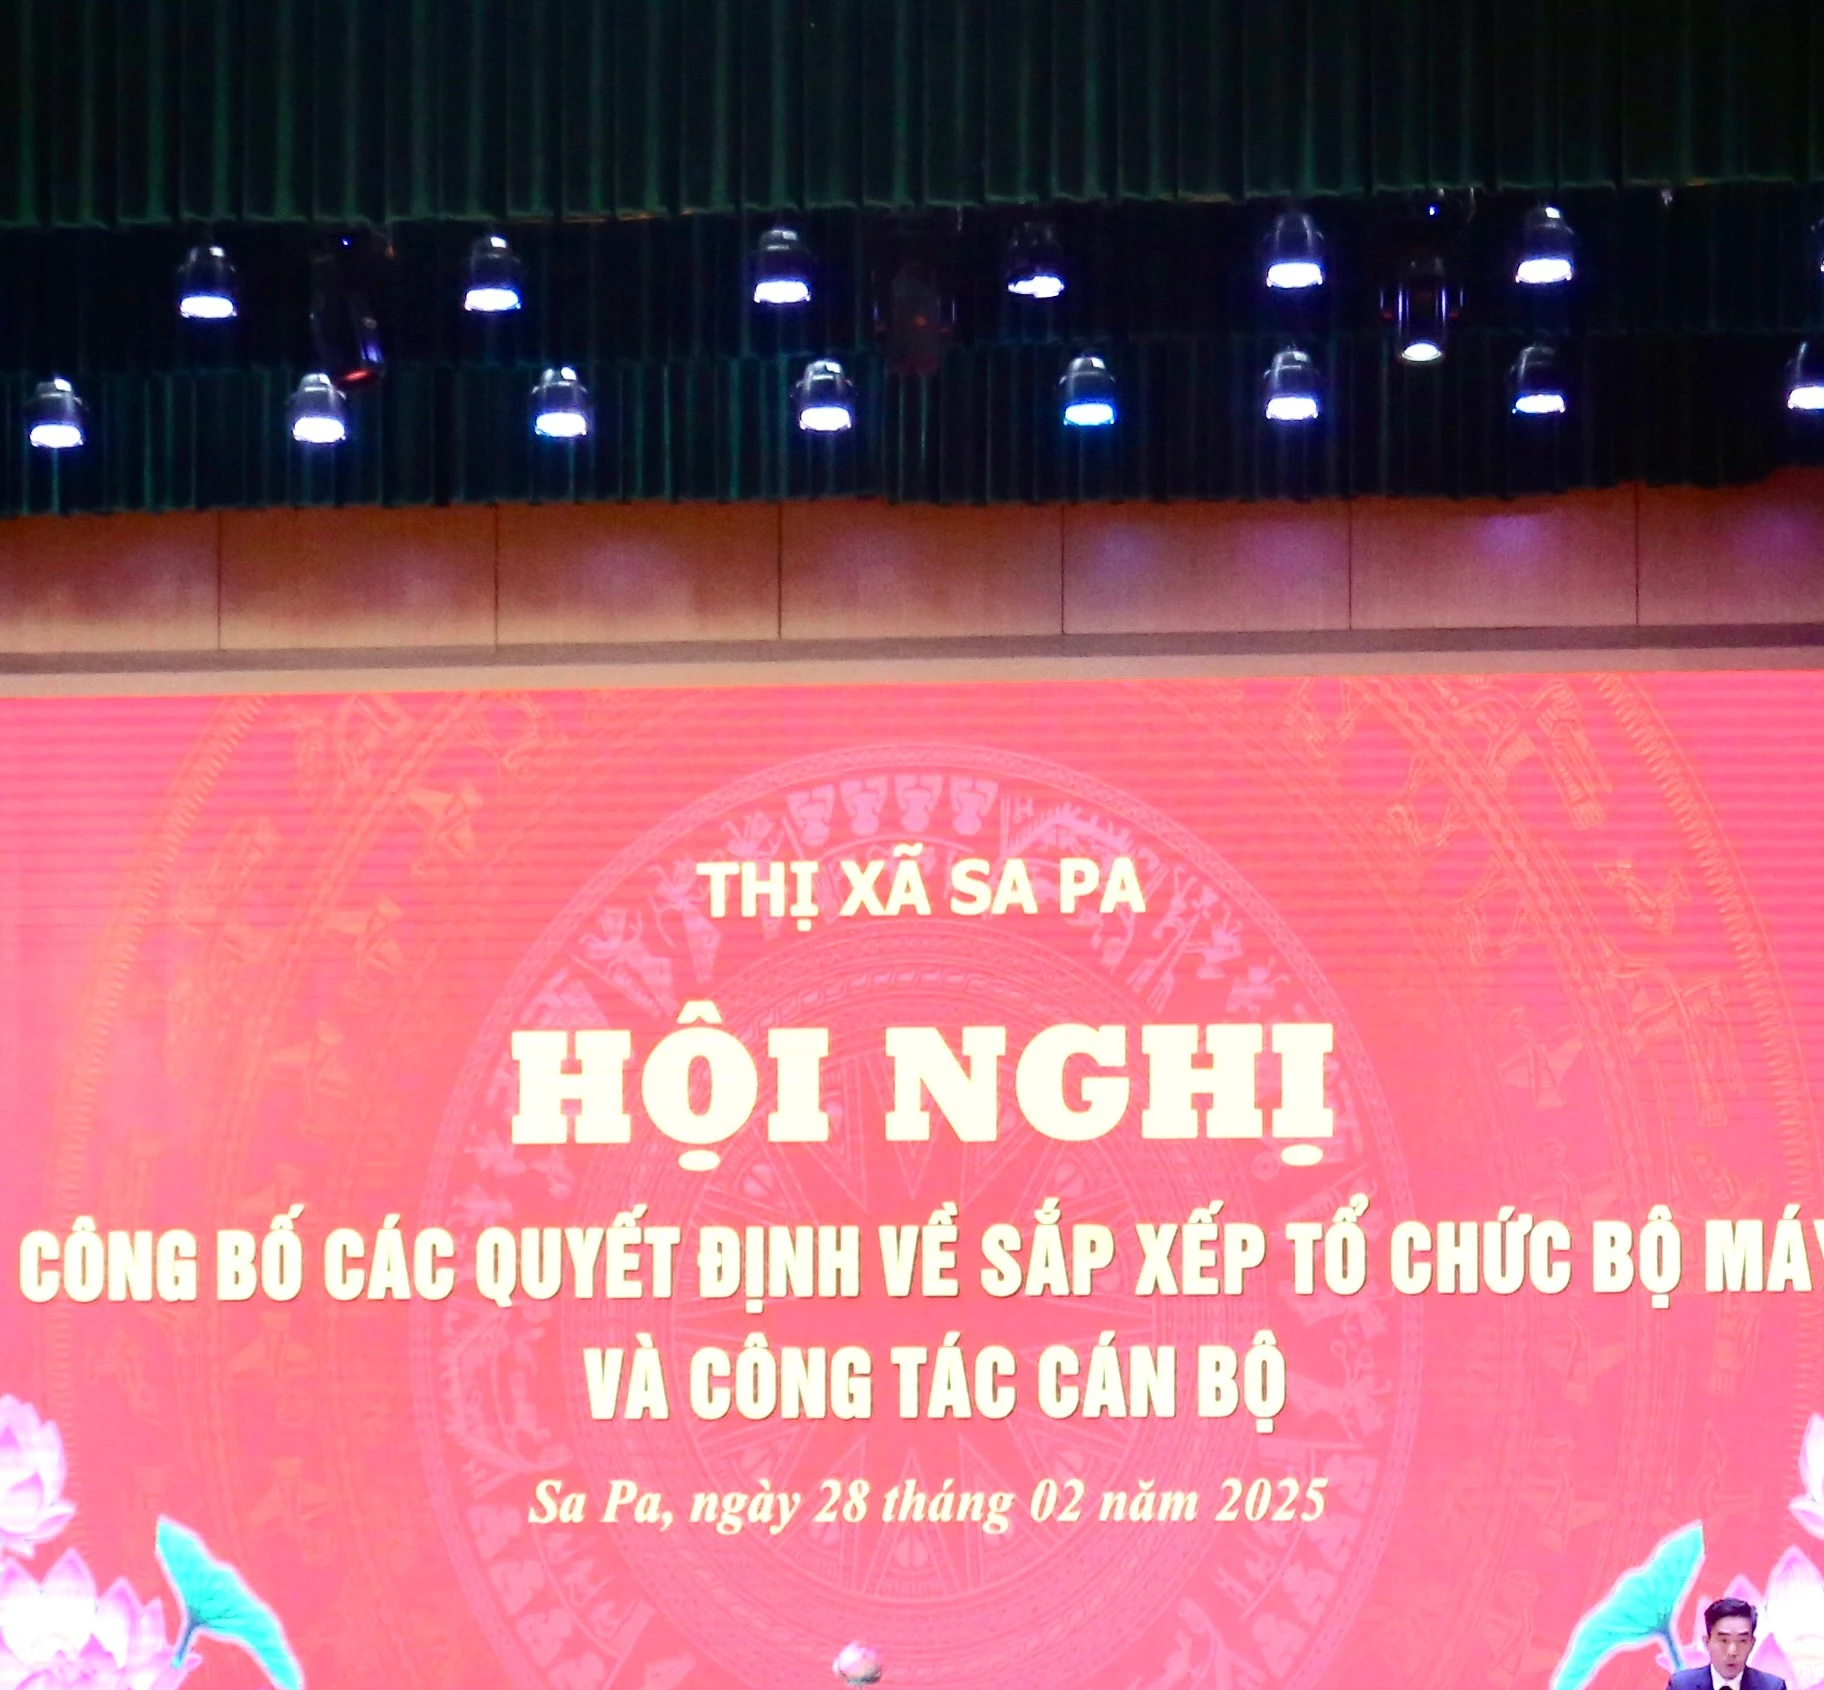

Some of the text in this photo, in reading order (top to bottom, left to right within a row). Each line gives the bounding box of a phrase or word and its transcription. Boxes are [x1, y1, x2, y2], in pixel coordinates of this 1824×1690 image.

[696, 843, 1146, 931] THỊ XÃ SA PA
[511, 1000, 1334, 1171] HỘI NGHỊ
[19, 1215, 197, 1302] CÔNG
[217, 1204, 304, 1301] BỐ
[324, 1213, 455, 1301] CÁC
[476, 1203, 681, 1307] QUYẾT
[697, 1225, 859, 1313] ĐỊNH
[879, 1201, 958, 1296] VỀ
[981, 1197, 1114, 1297] SẮP
[1135, 1200, 1265, 1295] XẾP
[1285, 1194, 1369, 1295] TỔ
[1391, 1206, 1571, 1294] CHỨC
[1593, 1205, 1681, 1309] BỘ
[583, 1329, 1285, 1433] VÀ CÔNG TÁC CÁN BỘ
[528, 1477, 1329, 1535] Sa Pa, ngày 28 tháng 02 năm 2025
